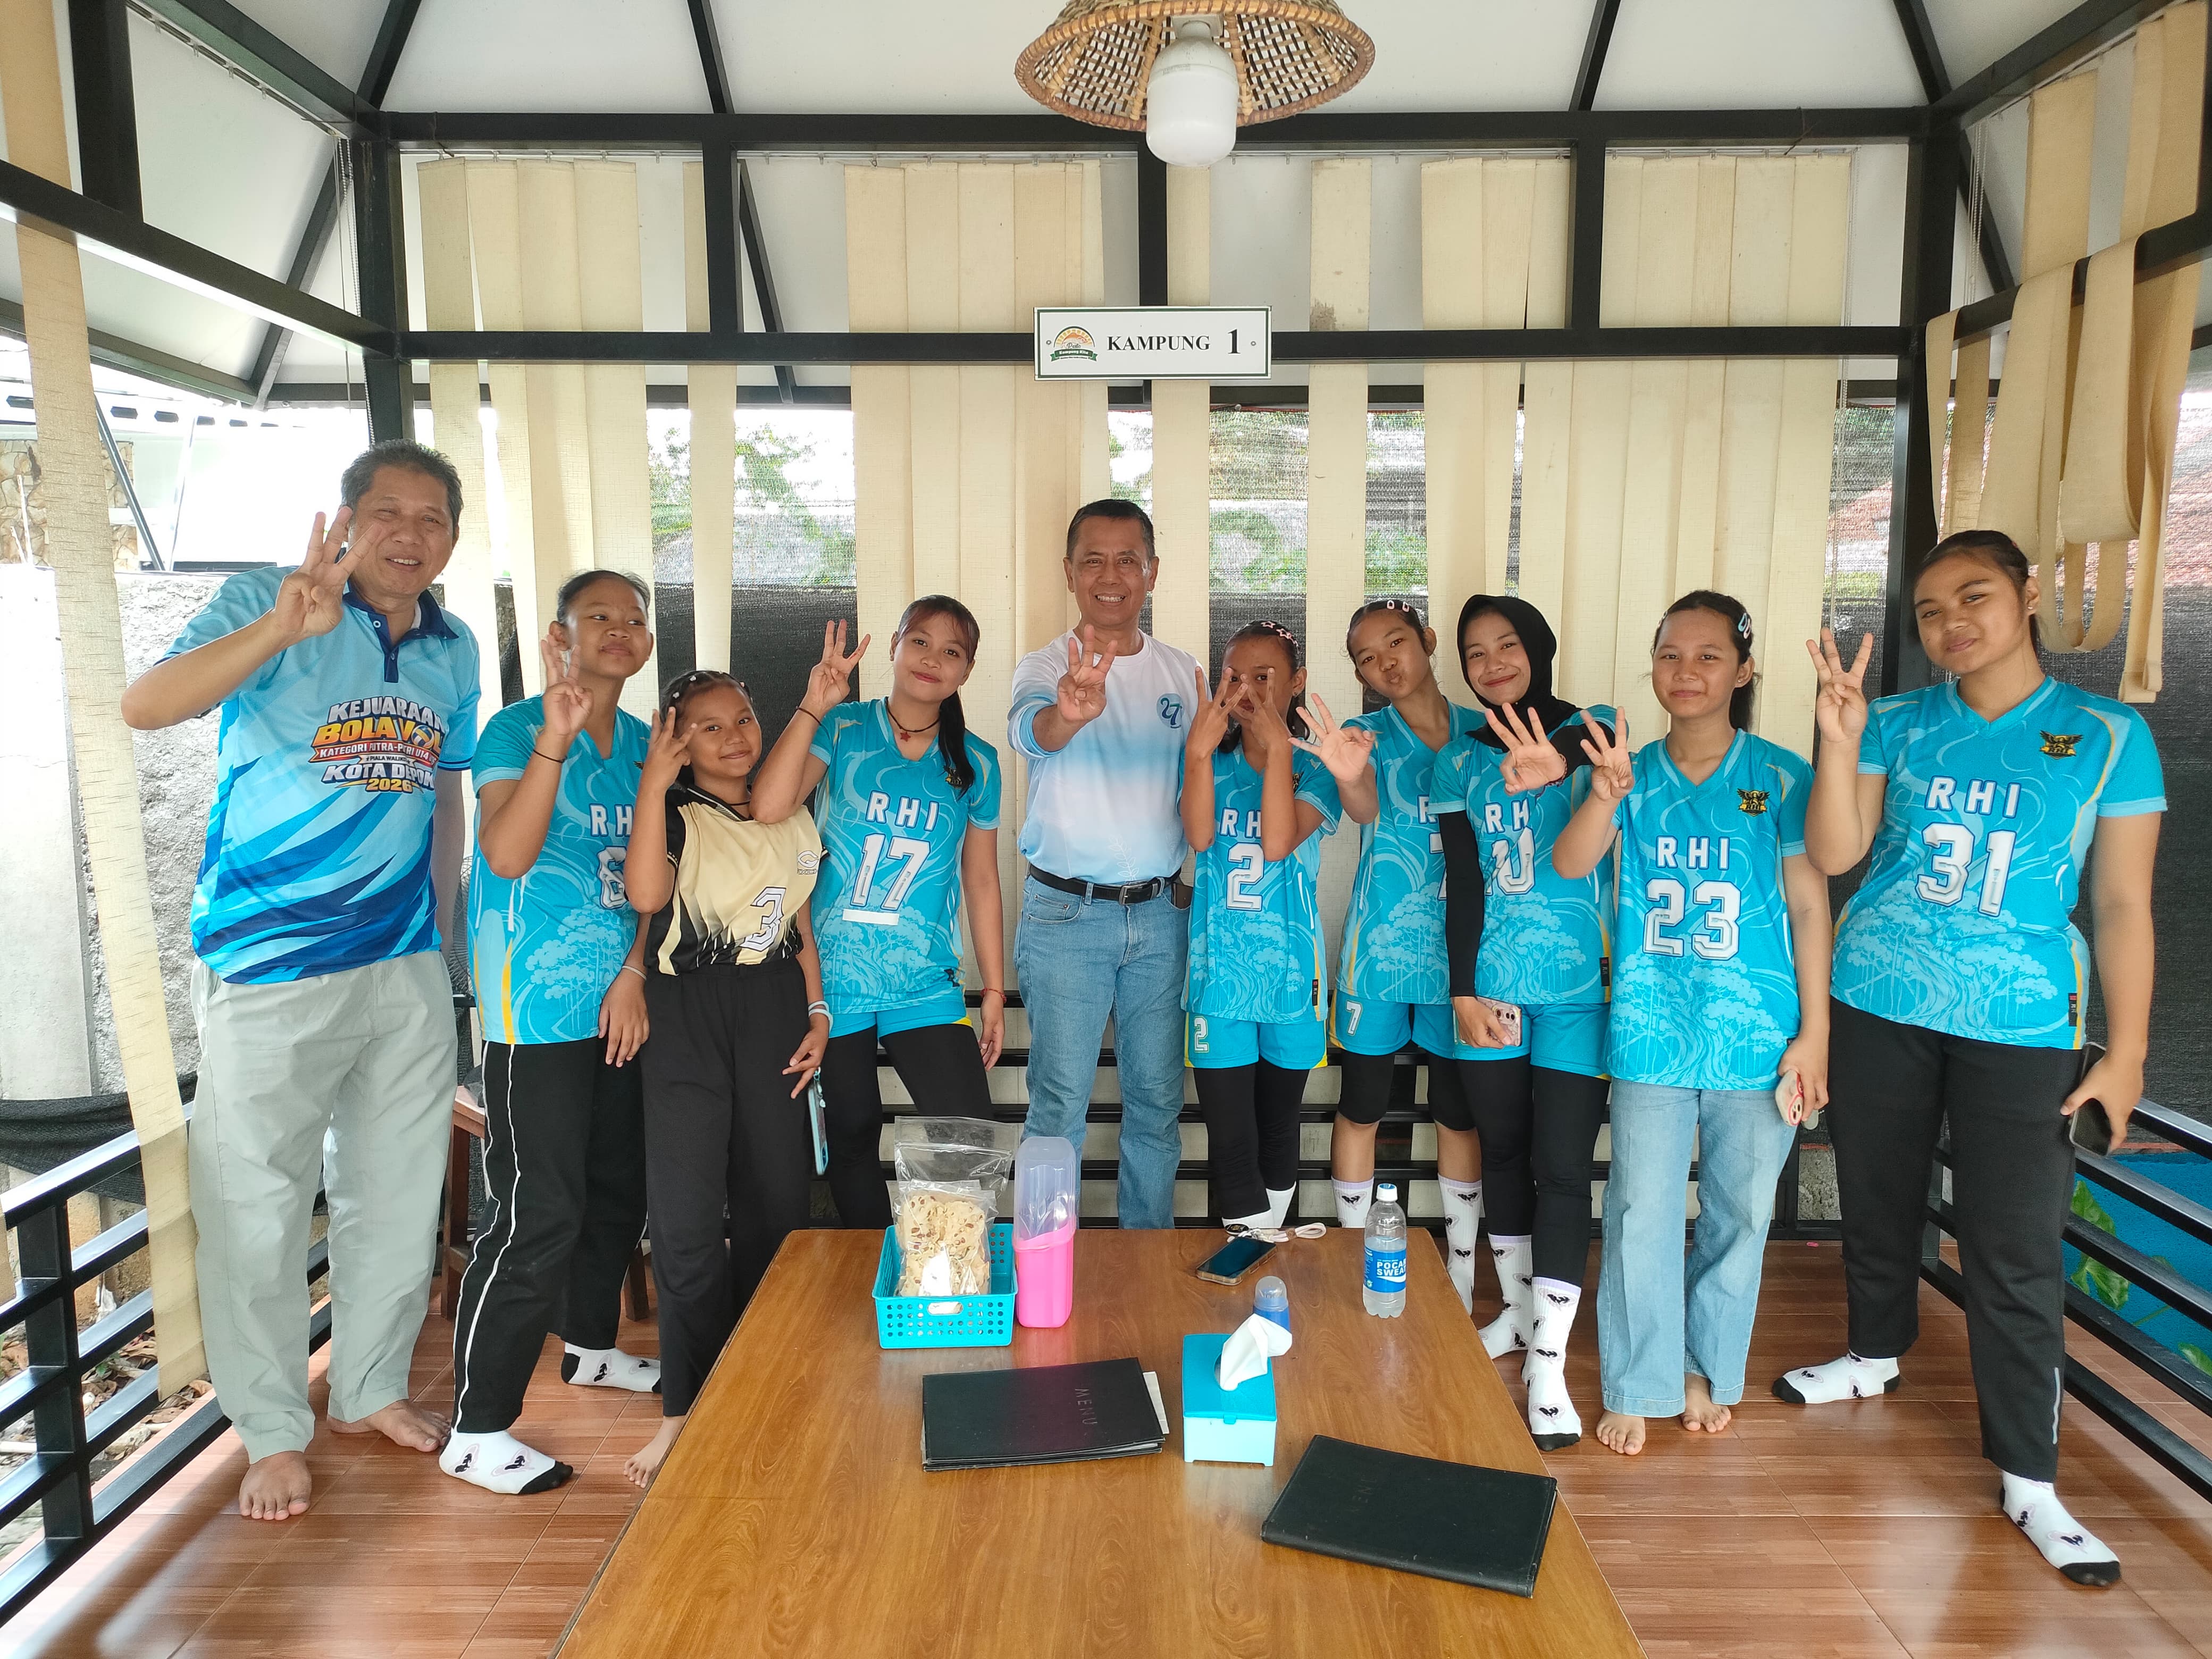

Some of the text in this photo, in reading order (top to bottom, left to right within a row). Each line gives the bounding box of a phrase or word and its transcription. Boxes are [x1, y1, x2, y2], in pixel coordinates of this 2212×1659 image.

[1107, 329, 1241, 354] KAMPUNG 1
[312, 716, 398, 747] BOLA
[320, 743, 367, 759] KATEGORI
[322, 763, 387, 784] KOTA
[365, 778, 414, 793] 2026
[866, 790, 940, 832] RHI
[1924, 775, 2021, 819] RHI
[589, 803, 634, 836] RH
[1220, 807, 1262, 839] RH
[1484, 798, 1530, 834] RH
[1655, 835, 1730, 870] RHI
[1915, 822, 2017, 917] 31
[850, 833, 931, 911] 17
[1226, 842, 1264, 912] 2
[739, 886, 787, 952] 3
[1643, 878, 1741, 961] 23
[1193, 1016, 1210, 1053] 2
[1346, 1000, 1363, 1036] 7
[1074, 1388, 1099, 1425] MENU
